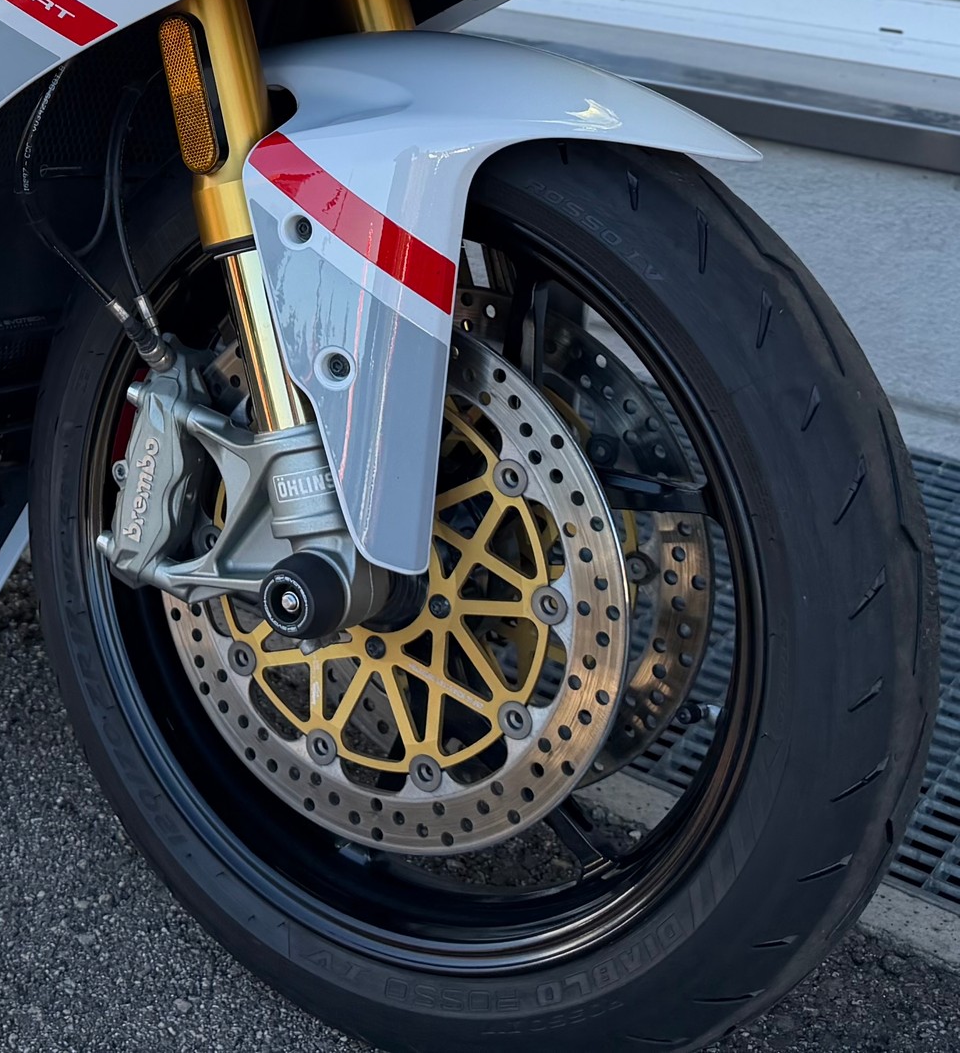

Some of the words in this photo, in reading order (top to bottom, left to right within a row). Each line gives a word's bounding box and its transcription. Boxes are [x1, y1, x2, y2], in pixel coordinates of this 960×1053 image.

[525, 182, 623, 246] ROSSO
[625, 250, 666, 282] IV
[122, 437, 160, 543] brembo
[305, 949, 374, 982] IV
[385, 976, 521, 1012] ROSSO
[536, 912, 685, 1007] DIABLO
